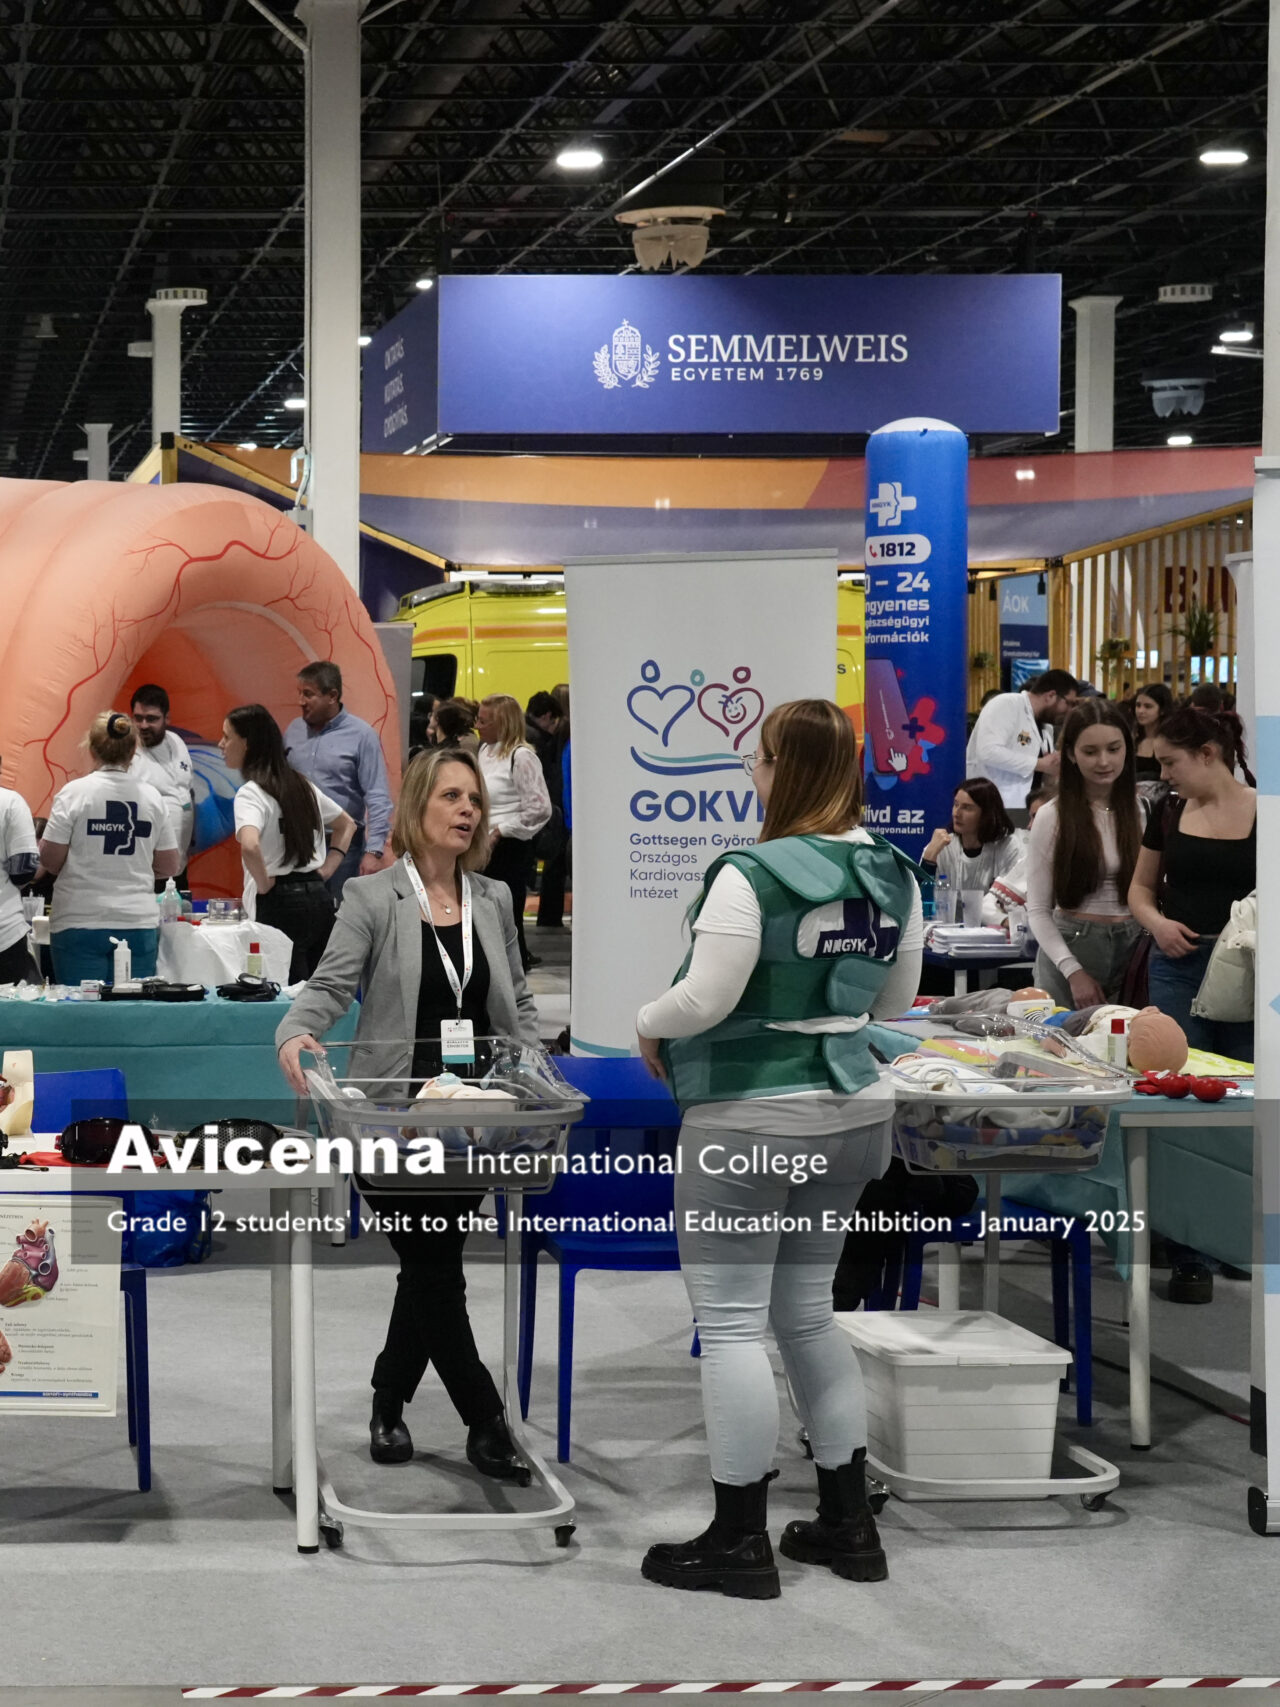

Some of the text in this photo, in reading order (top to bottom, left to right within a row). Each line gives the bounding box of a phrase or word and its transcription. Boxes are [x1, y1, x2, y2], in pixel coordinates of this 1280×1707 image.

[667, 334, 908, 363] SEMMELWEIS
[671, 367, 823, 381] EGYETEM 1769
[879, 541, 915, 557] 1812
[896, 571, 930, 592] 24
[865, 598, 929, 615] ngyenes
[1002, 589, 1030, 613] ÁOK
[629, 789, 766, 823] GOKVI
[897, 809, 925, 824] az
[91, 823, 125, 832] NNGYK
[629, 833, 707, 849] Gottsegen
[629, 850, 698, 867] Országos
[629, 868, 705, 882] Kardiovasz
[629, 886, 679, 899] Intézet
[822, 938, 868, 954] NNGYK
